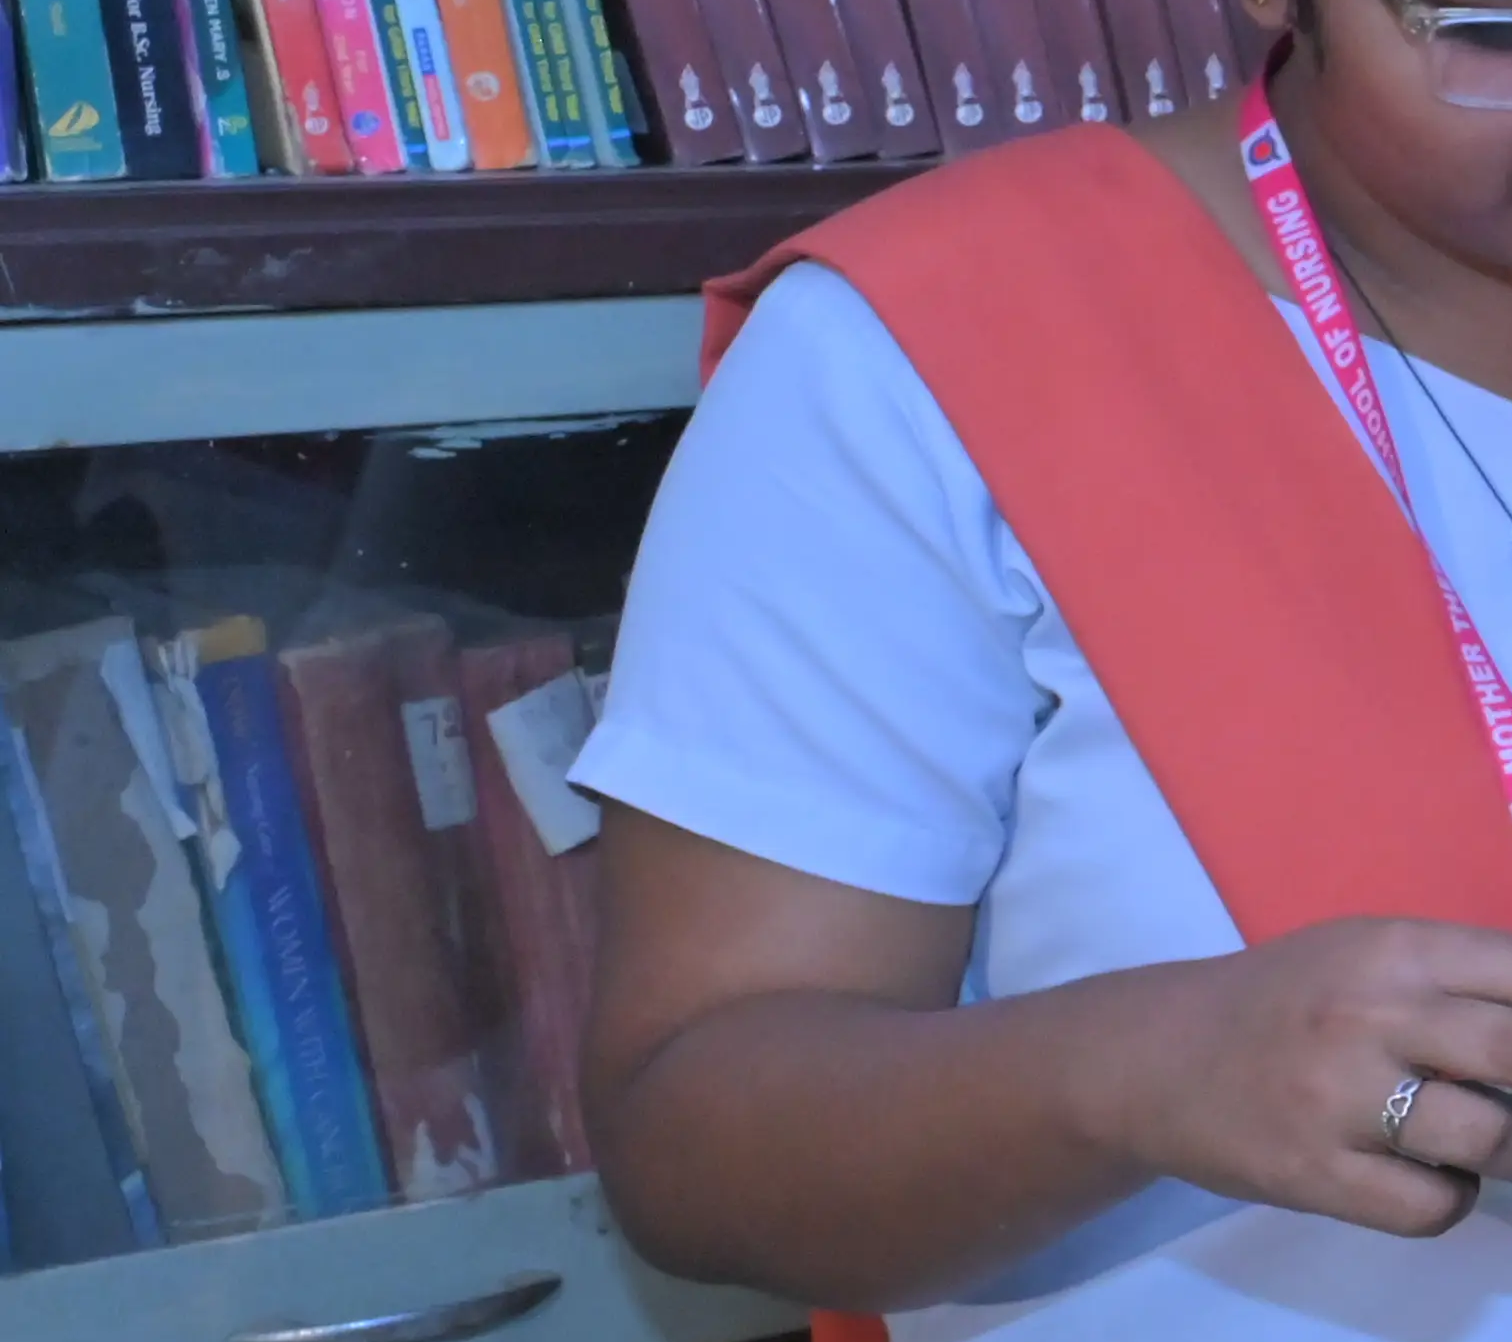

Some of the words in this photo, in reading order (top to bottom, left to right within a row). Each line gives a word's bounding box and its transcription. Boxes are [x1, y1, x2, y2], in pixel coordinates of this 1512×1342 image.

[139, 66, 163, 137] Nursing
[1265, 188, 1343, 321] NURSING
[1326, 327, 1365, 365] OF
